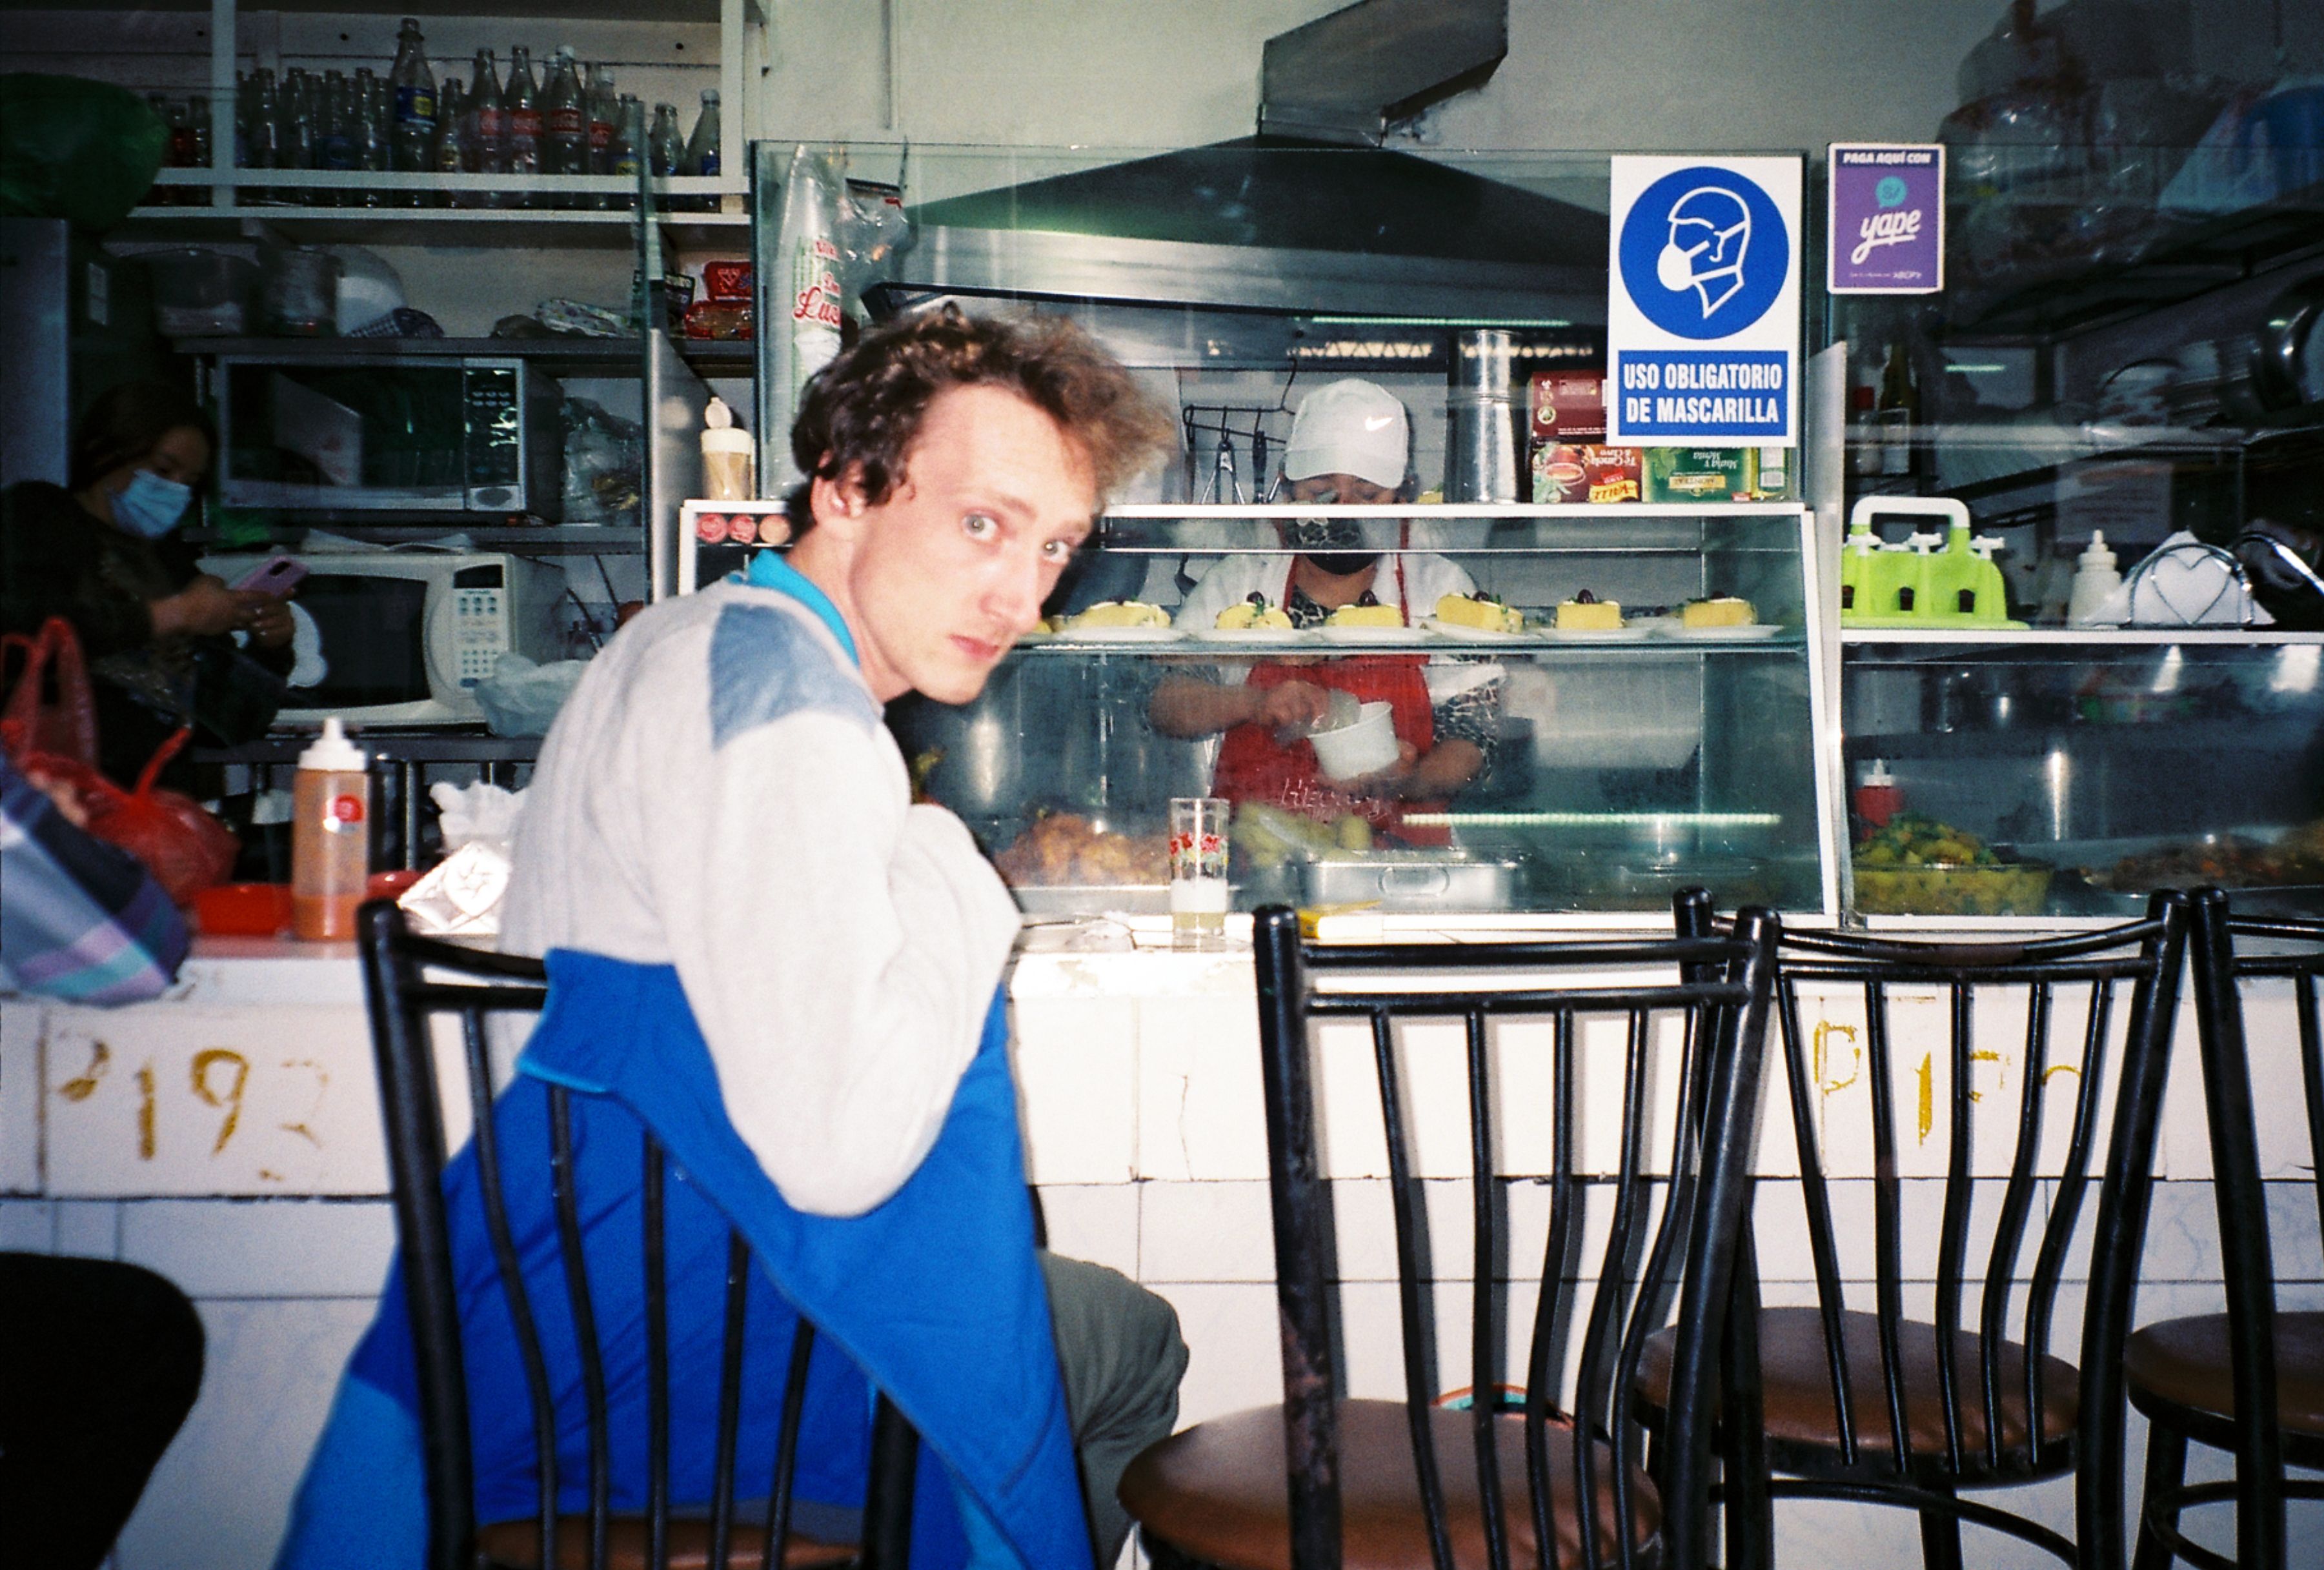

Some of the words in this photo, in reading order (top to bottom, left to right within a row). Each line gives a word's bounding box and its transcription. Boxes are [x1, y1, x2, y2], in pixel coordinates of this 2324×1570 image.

[1843, 152, 1874, 164] PAGA
[1906, 152, 1932, 164] CON
[1850, 210, 1922, 265] yape
[1623, 363, 1660, 390] USO
[1664, 363, 1783, 390] OBLIGATORIO
[1626, 397, 1652, 423] DE
[1656, 396, 1779, 424] MASCARILLA
